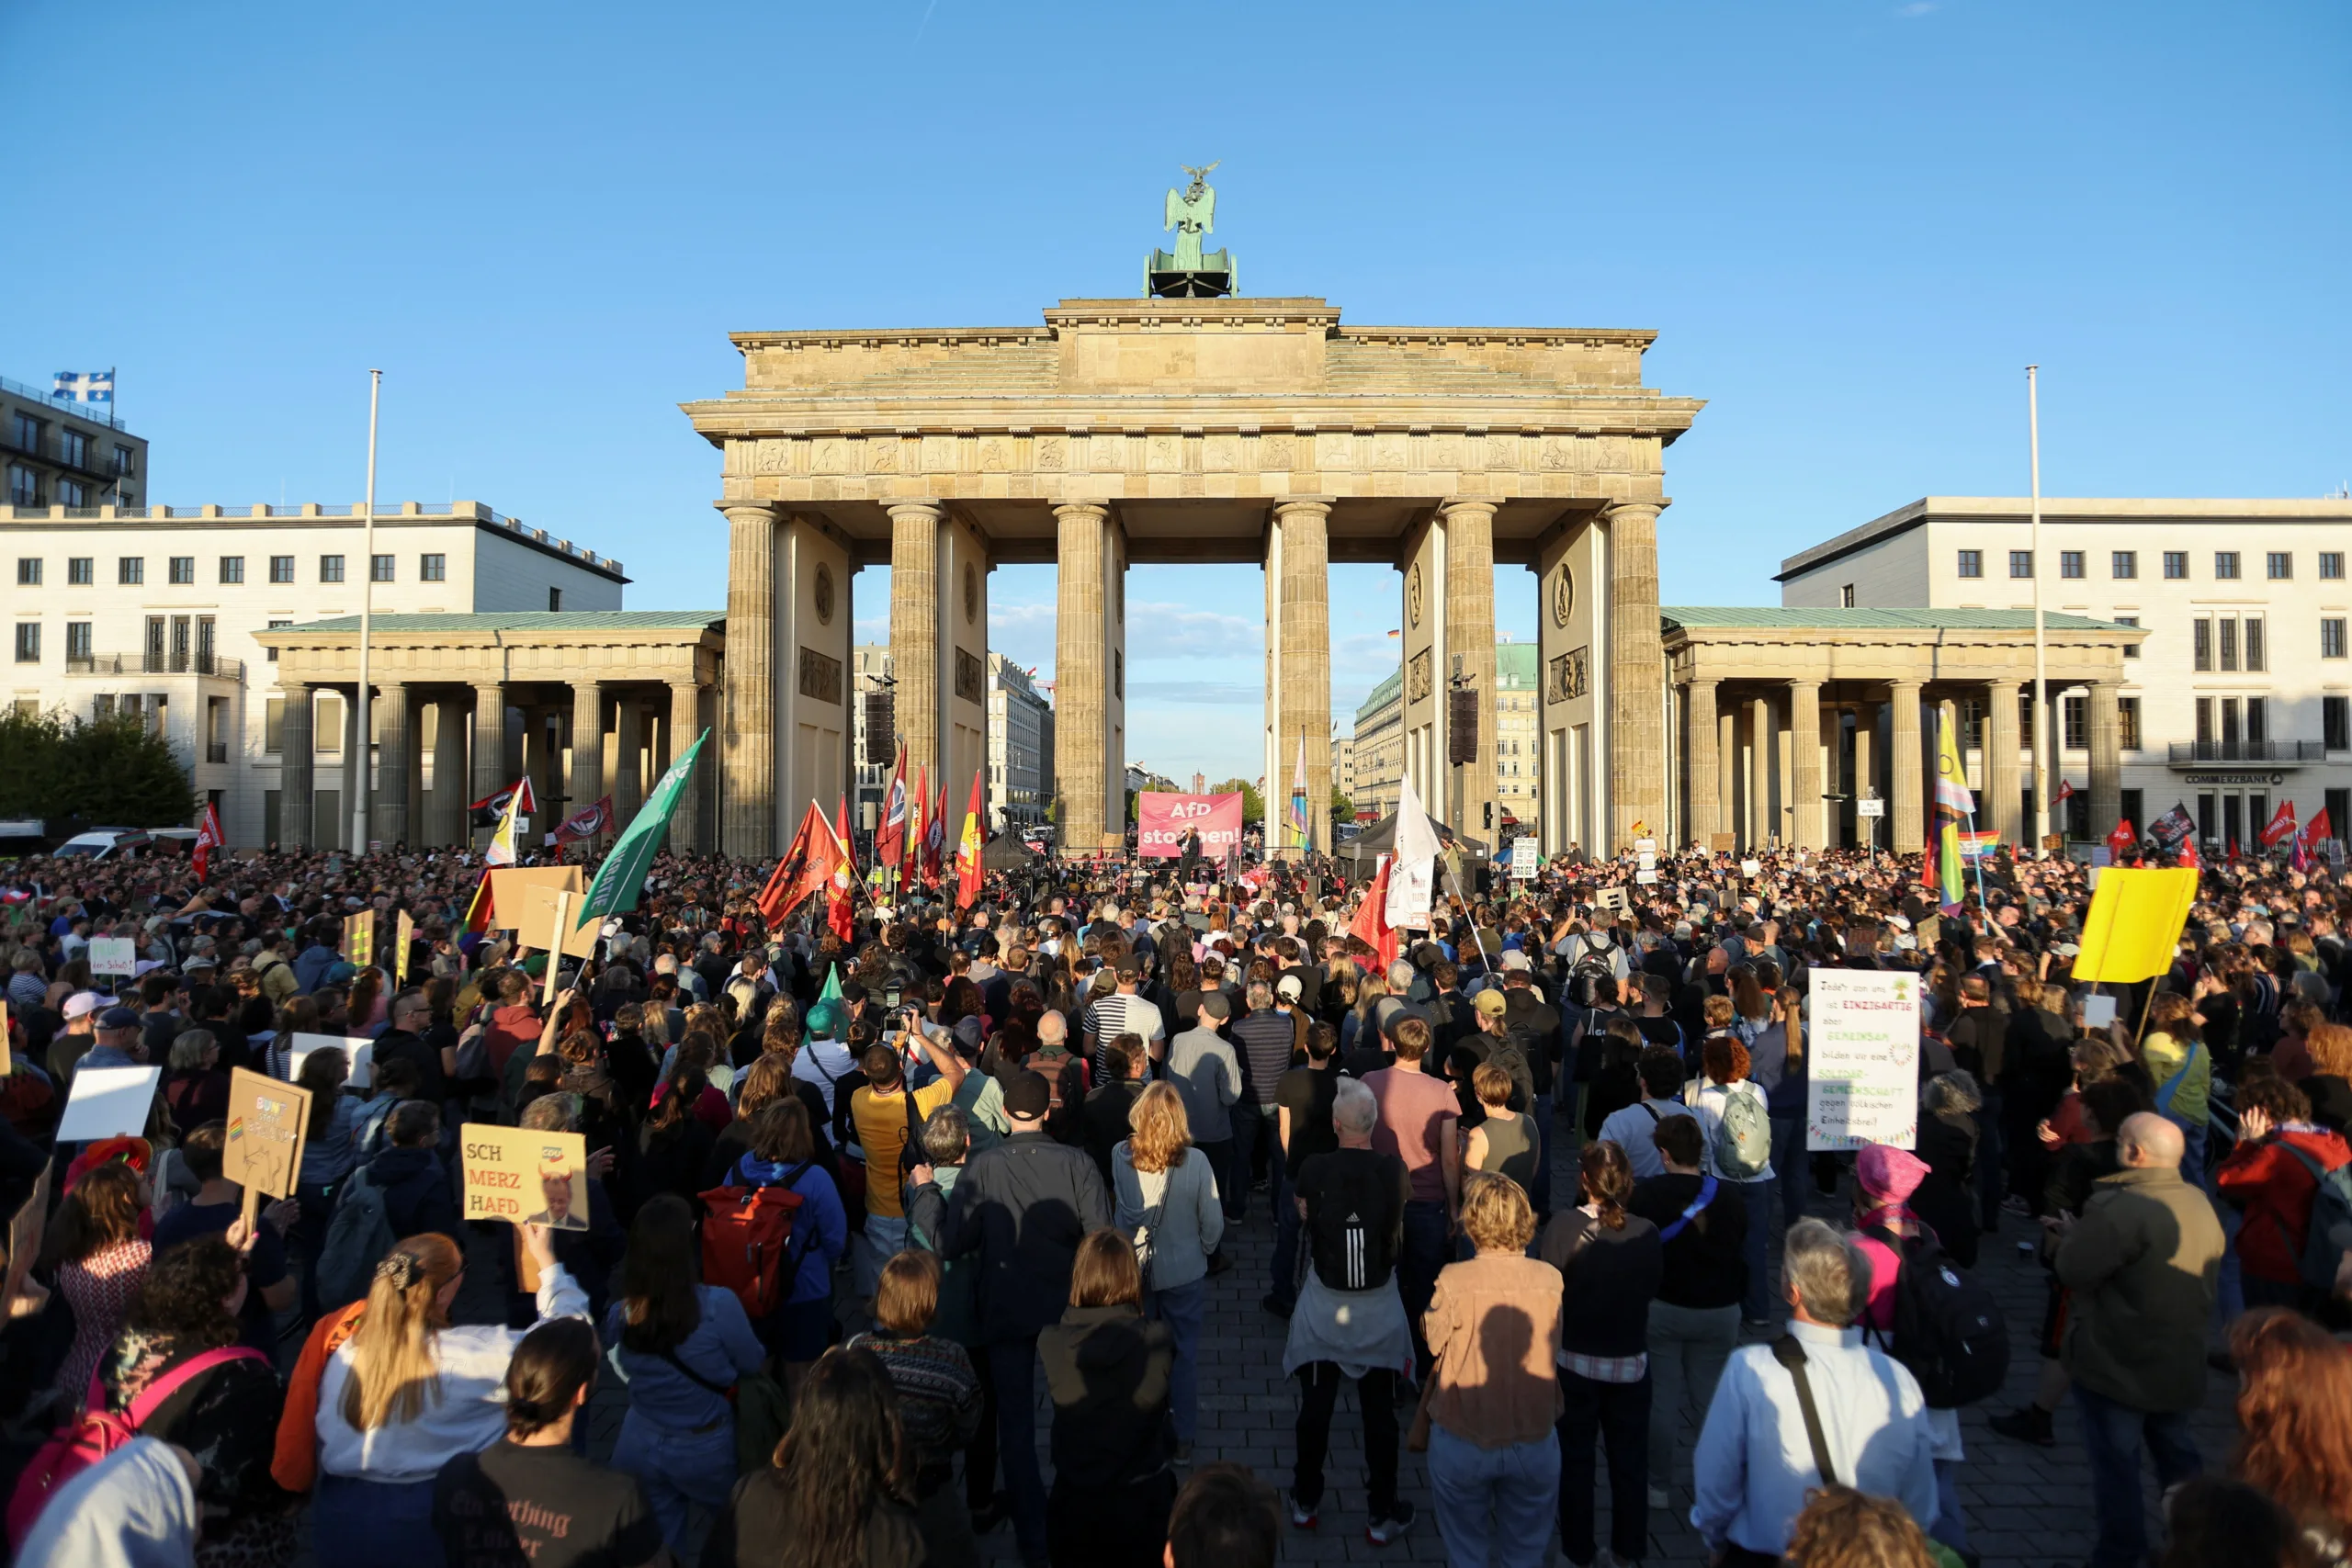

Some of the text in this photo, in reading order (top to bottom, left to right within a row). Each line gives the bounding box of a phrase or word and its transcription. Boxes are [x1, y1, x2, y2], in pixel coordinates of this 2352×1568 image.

[2185, 774, 2268, 784] COMMERZBANK
[1170, 802, 1212, 818] AfD
[1143, 827, 1239, 844] stoen!
[826, 886, 841, 902] SIND
[1842, 1000, 1913, 1011] EINZIGARTIG
[1826, 1031, 1890, 1042] GEMEINSAM
[1822, 1086, 1905, 1098] GEMEINSCHAFT
[255, 1095, 288, 1114] BUNT
[1818, 1100, 1846, 1111] gegen
[466, 1143, 502, 1162] SCH
[542, 1148, 561, 1156] CDU
[469, 1168, 521, 1190] MERZ
[469, 1194, 520, 1215] HAFD
